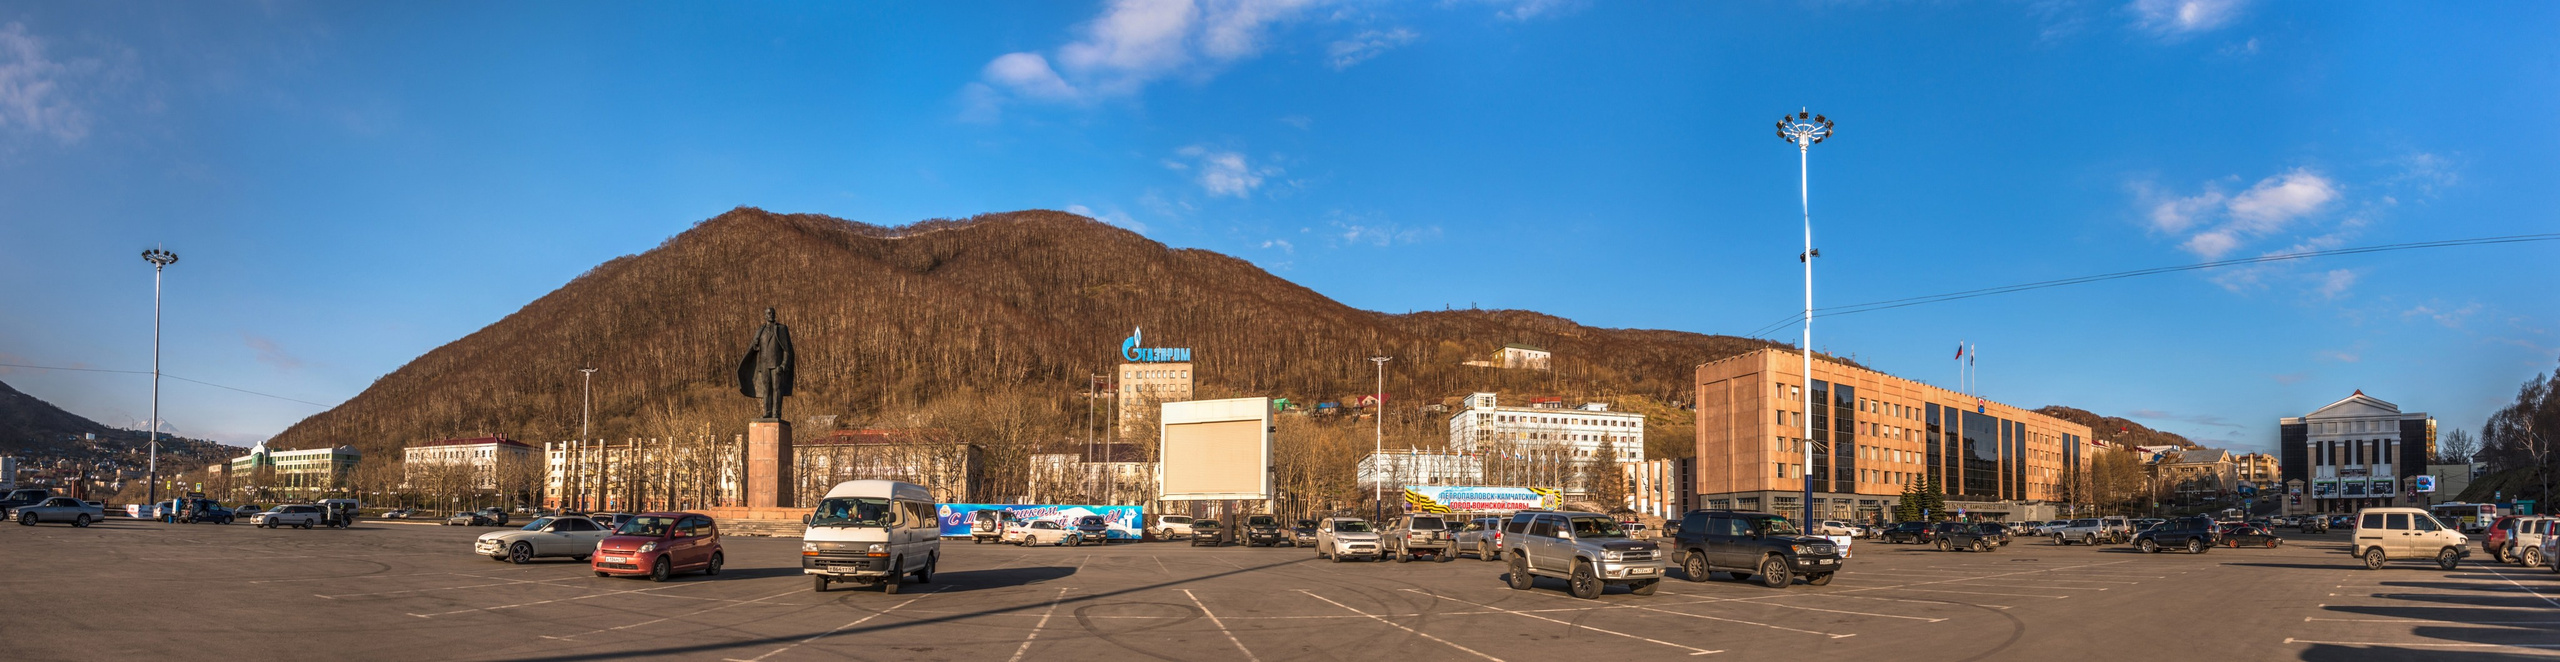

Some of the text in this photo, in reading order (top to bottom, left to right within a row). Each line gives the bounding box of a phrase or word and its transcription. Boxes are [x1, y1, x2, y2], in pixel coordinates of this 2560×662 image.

[1142, 348, 1191, 361] ГАЗПРОМ
[1450, 501, 1530, 510] ГОРОД ВОИНСКОЙ СЛАВЫ
